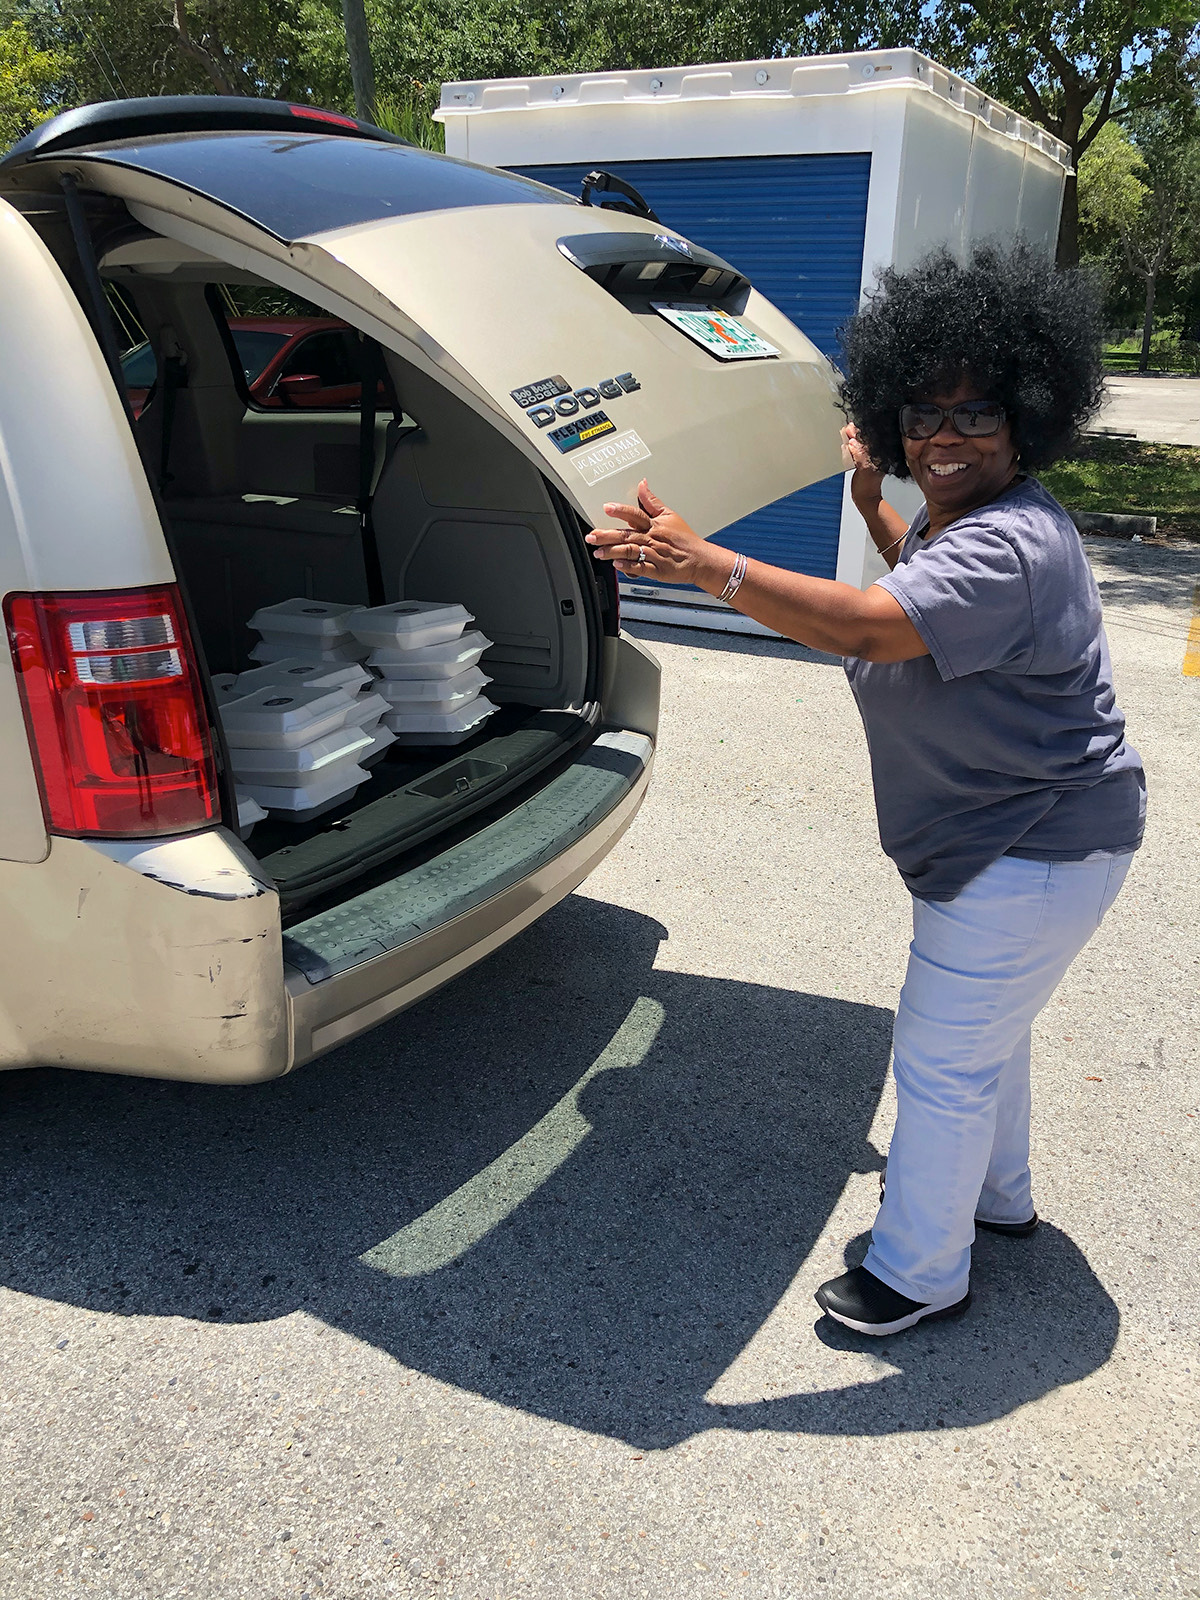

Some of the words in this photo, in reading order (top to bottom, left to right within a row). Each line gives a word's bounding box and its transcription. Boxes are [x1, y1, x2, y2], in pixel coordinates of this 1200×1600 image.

[513, 389, 532, 400] Bob
[530, 381, 556, 394] Boast
[520, 387, 560, 406] DODGE
[526, 372, 641, 429] DODGE
[551, 411, 607, 441] FLEXFUEL
[587, 445, 616, 467] AUTO
[614, 434, 641, 452] MAX
[592, 460, 615, 477] AUTO
[615, 447, 641, 464] SALES
